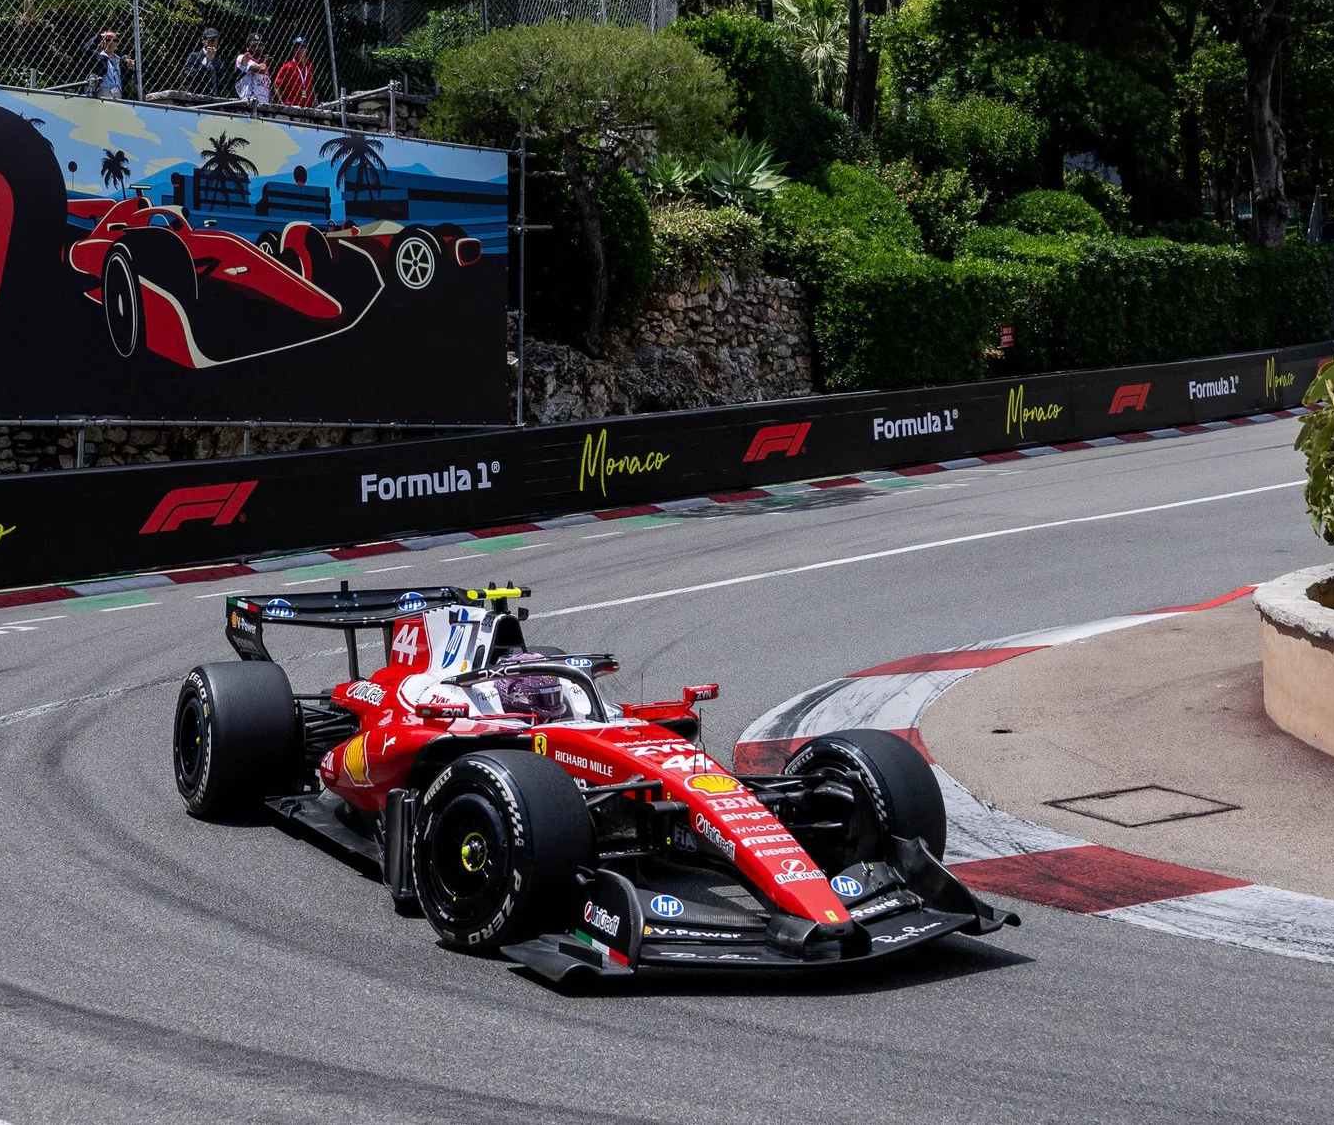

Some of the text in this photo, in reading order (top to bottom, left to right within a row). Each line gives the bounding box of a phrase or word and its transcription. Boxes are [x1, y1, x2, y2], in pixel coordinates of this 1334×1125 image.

[1189, 379, 1229, 400] Formula
[1265, 356, 1295, 400] Monaco
[1006, 384, 1063, 439] Monaco
[873, 412, 942, 441] Formula
[742, 421, 812, 462] F1
[579, 428, 671, 497] Monaco
[361, 466, 472, 503] Formula
[138, 480, 258, 534] F1
[392, 624, 418, 666] 44
[570, 658, 588, 666] hp
[695, 689, 712, 700] ZYN
[442, 707, 465, 717] ZYN
[627, 742, 701, 757] ZYN
[554, 750, 613, 778] RICHARD MILLE
[661, 753, 714, 772] 44
[706, 796, 764, 812] IBM
[703, 819, 736, 861] UniCredit
[774, 869, 827, 885] UniCredit
[838, 878, 857, 896] hp
[658, 897, 678, 916] hp
[468, 893, 515, 945] ZERO
[653, 927, 742, 939] V-Power
